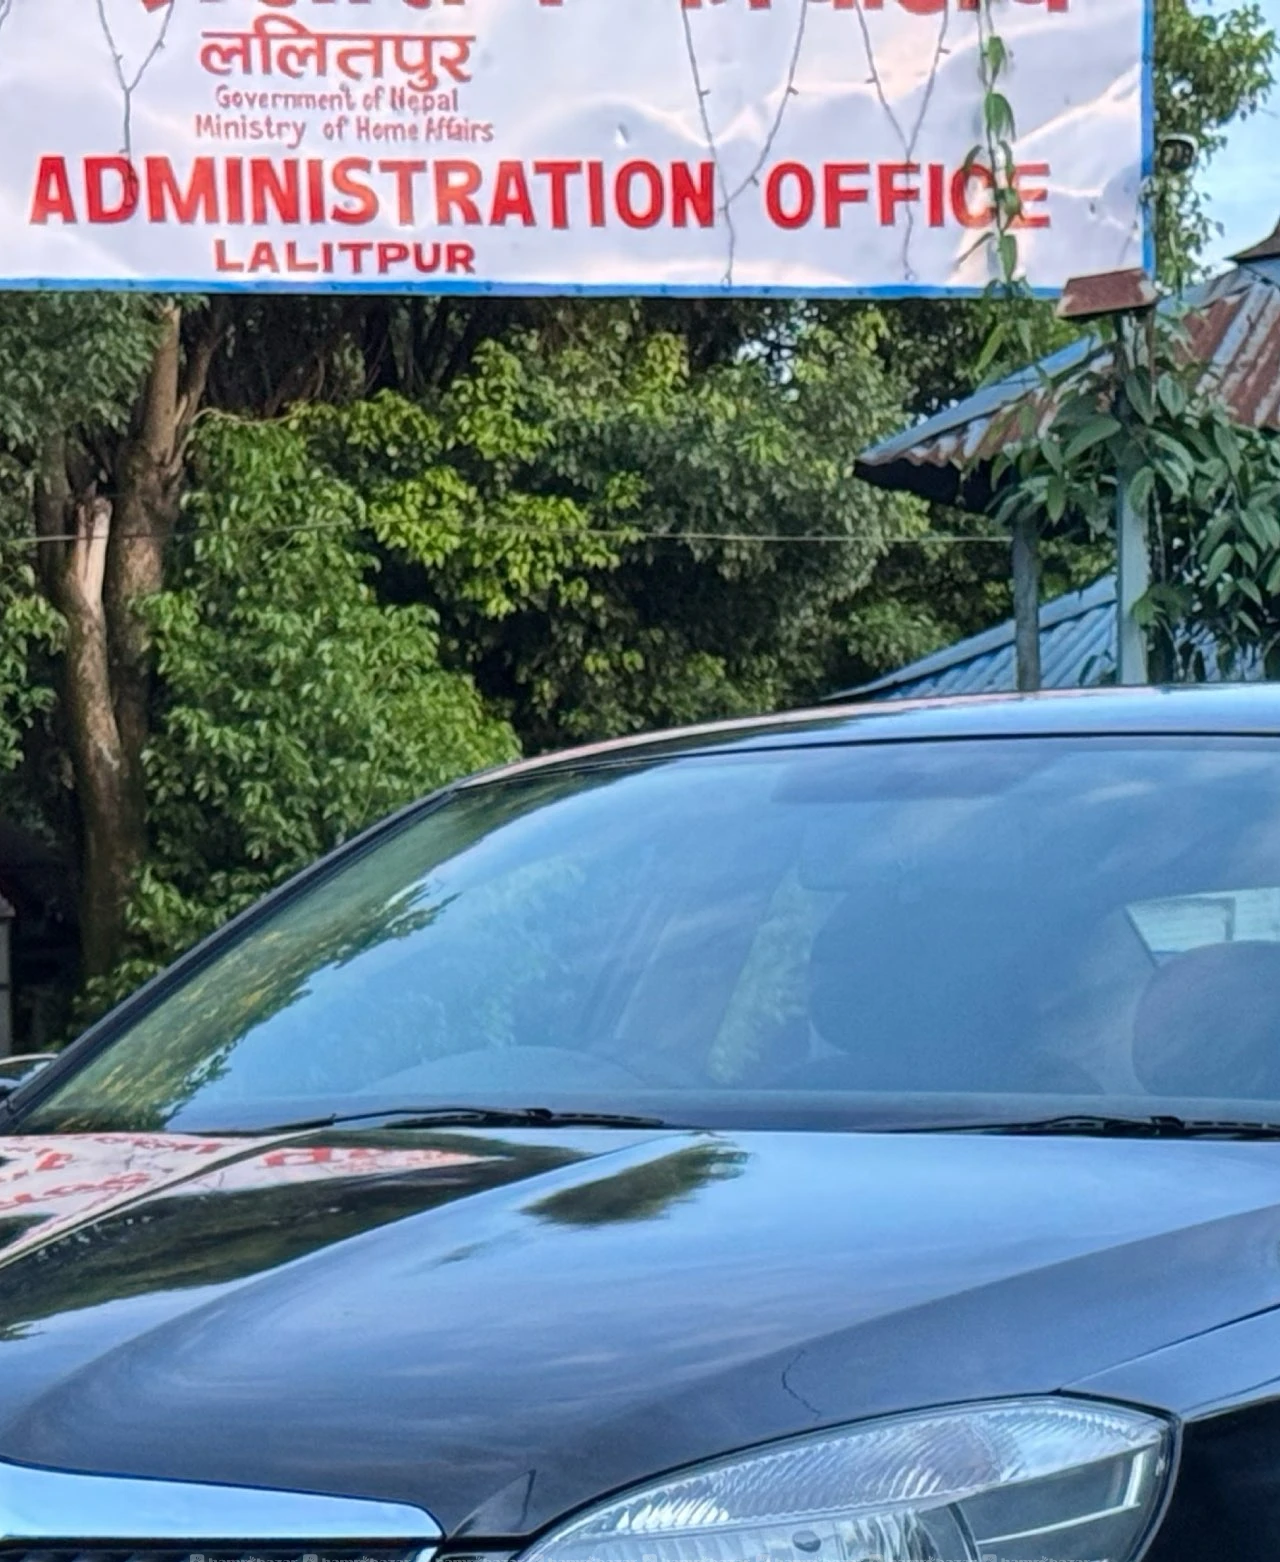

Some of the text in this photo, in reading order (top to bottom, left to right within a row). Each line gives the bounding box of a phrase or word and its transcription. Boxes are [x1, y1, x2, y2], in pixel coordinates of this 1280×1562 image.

[199, 13, 477, 92] ललितपुर
[215, 83, 459, 114] Government of Nepal
[194, 114, 495, 149] Ministry of Home Affairs
[30, 155, 715, 229] ADMINISTRATION
[765, 161, 1051, 230] OFFICE
[214, 238, 477, 275] LALITPUR
